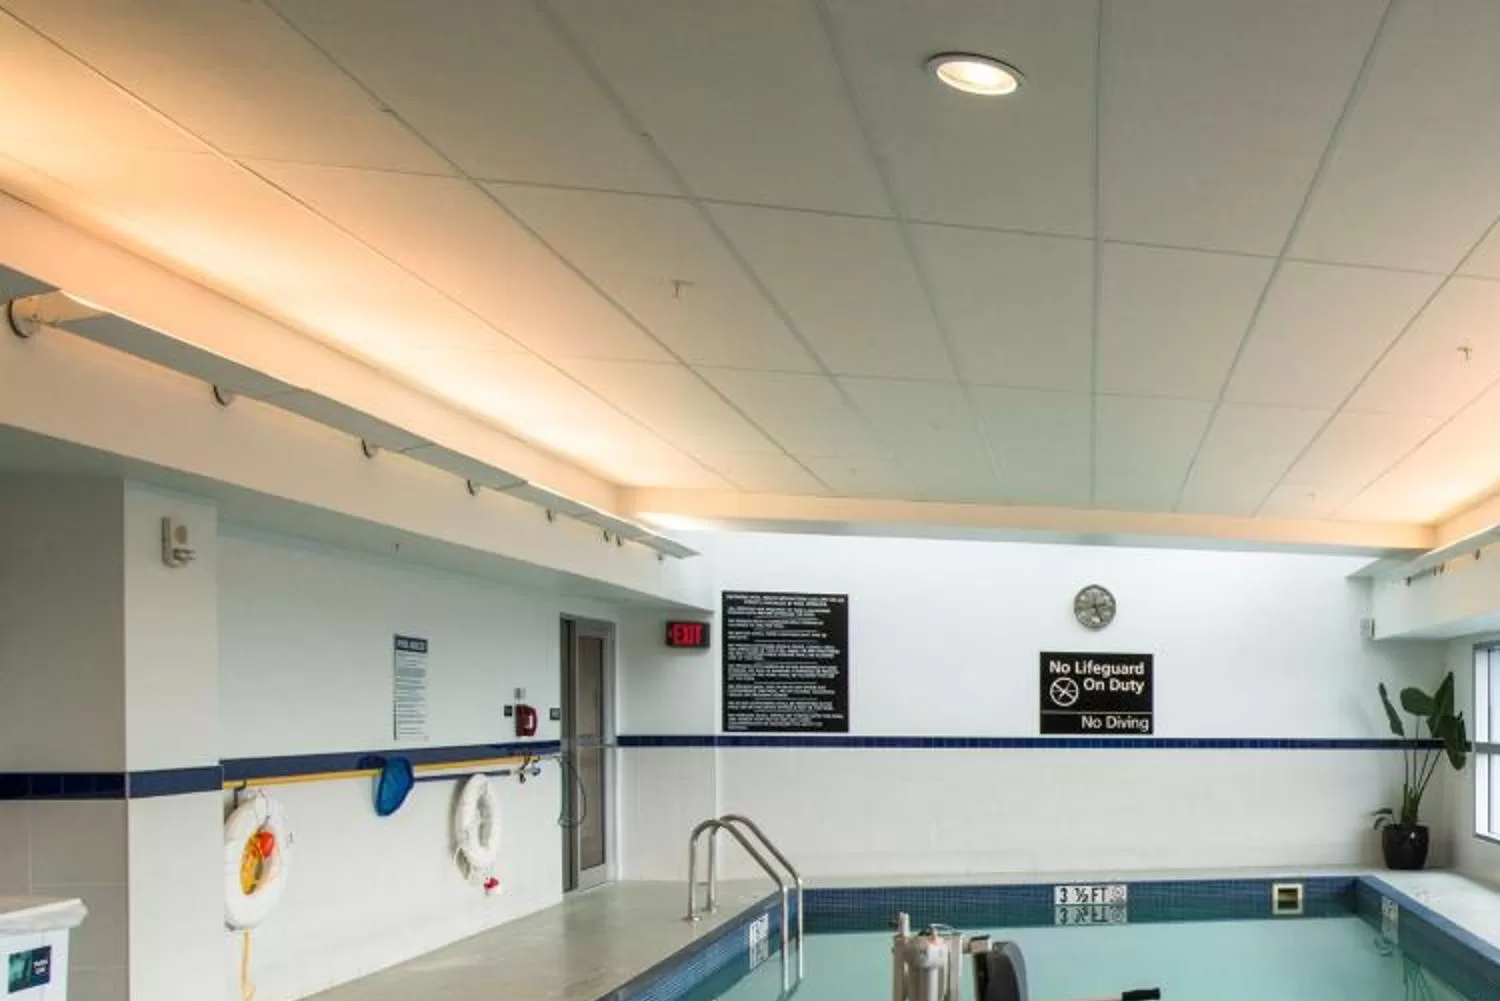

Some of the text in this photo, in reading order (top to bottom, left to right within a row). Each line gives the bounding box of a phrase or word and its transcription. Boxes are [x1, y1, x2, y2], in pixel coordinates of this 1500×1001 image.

[672, 624, 702, 645] EXIT
[1049, 660, 1145, 678] No Lifeguard
[1083, 677, 1145, 695] On Duty
[1081, 715, 1149, 732] No Diving
[1060, 887, 1068, 903] 3
[1091, 887, 1108, 903] FT
